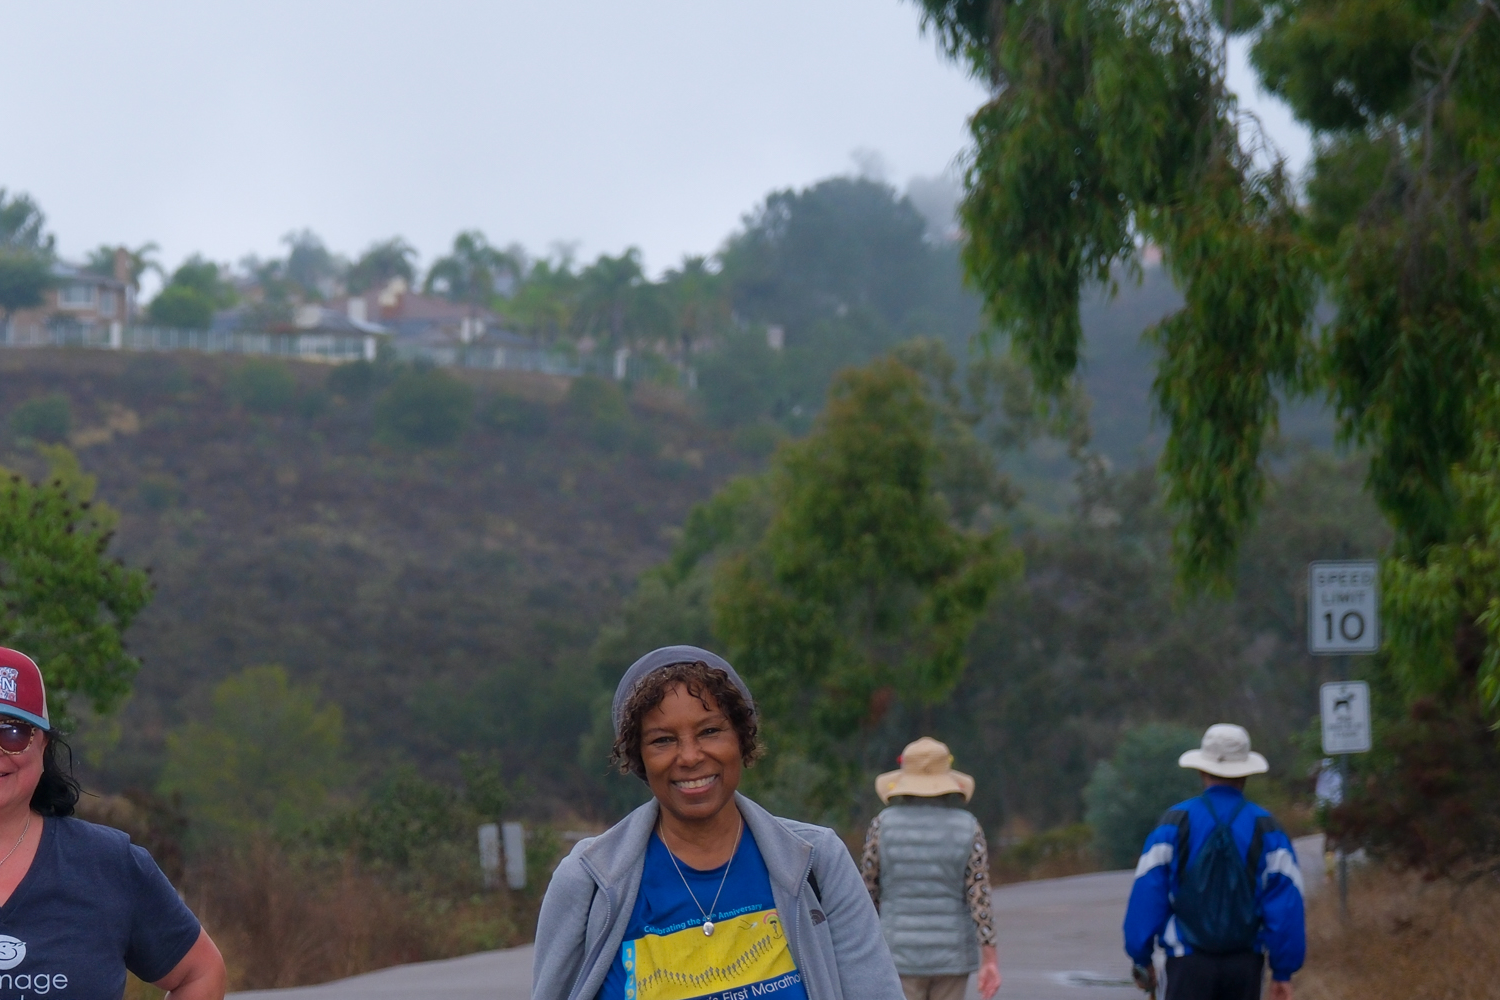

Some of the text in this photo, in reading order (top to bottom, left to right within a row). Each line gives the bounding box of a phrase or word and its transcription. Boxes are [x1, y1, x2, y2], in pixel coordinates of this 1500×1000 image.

[1317, 571, 1371, 587] SPEED
[1322, 590, 1366, 607] LIMIT
[1324, 610, 1365, 642] 10
[644, 923, 687, 935] Celebrating
[687, 918, 700, 926] the
[718, 904, 763, 919] Anniversary
[751, 973, 801, 997] Maratho
